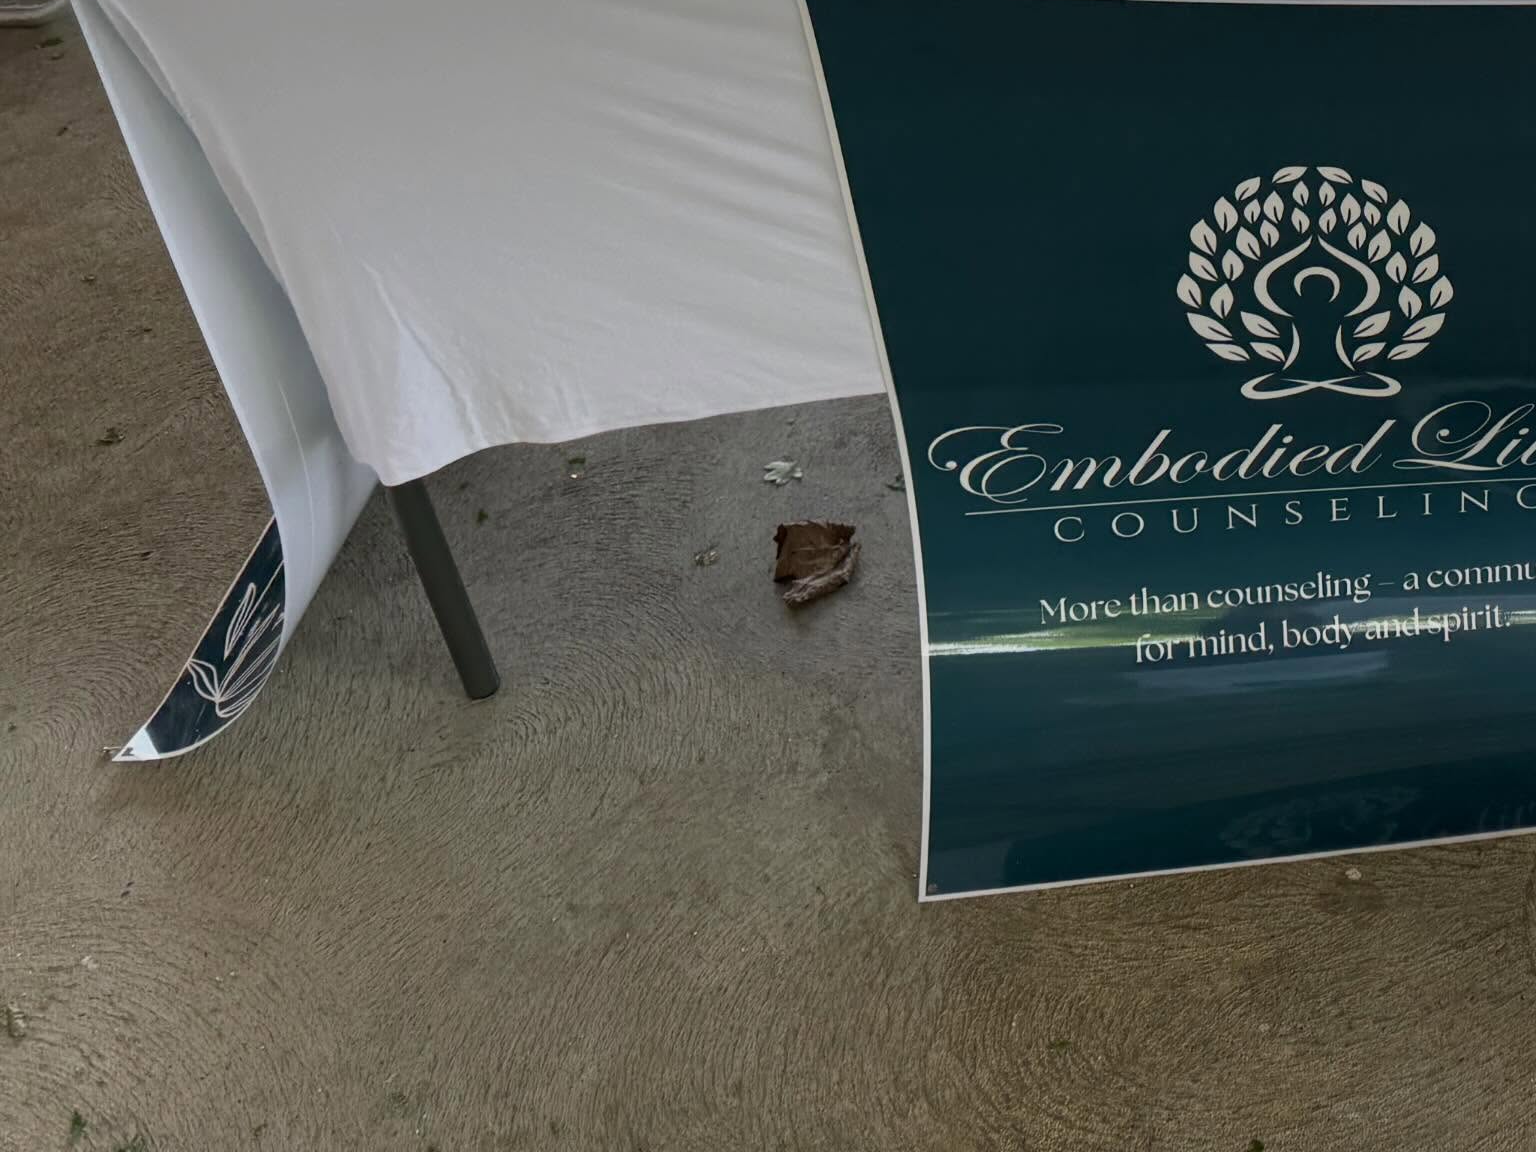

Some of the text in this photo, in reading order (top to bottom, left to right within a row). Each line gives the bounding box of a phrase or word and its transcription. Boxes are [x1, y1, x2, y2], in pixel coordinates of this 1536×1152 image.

[927, 418, 1397, 504] Embodied
[1039, 597, 1122, 625] More
[1129, 586, 1200, 616] than
[1206, 570, 1372, 609] counseling
[1402, 571, 1420, 591] a
[1135, 603, 1513, 664] for mind, body and spirit.
